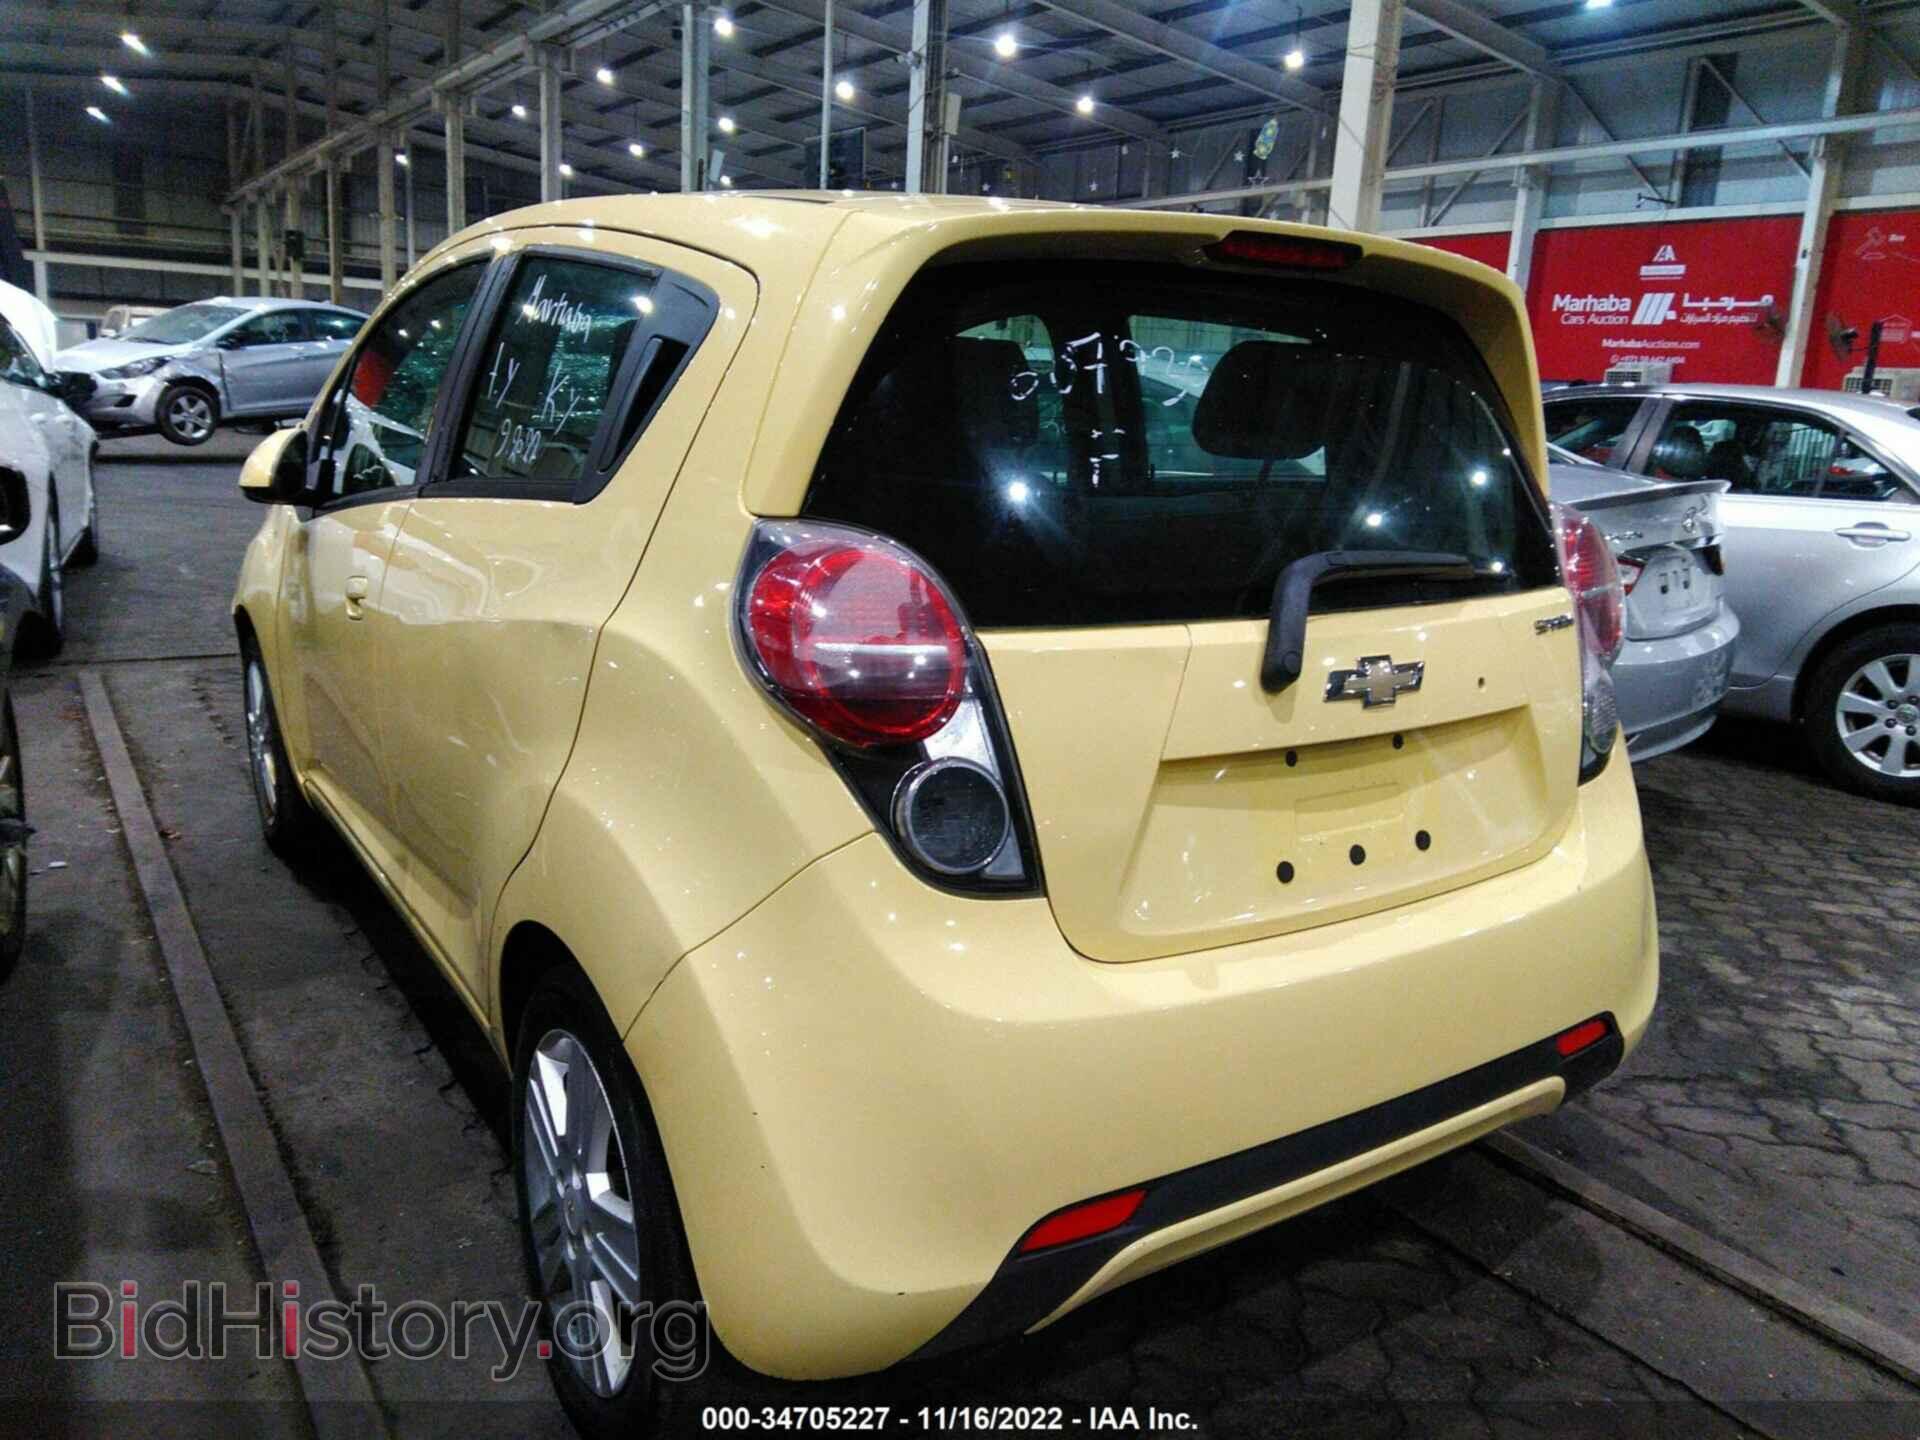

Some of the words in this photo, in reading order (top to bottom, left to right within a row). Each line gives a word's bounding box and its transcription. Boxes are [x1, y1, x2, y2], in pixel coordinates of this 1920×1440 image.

[1552, 294, 1632, 312] Marhaba
[1560, 312, 1585, 325] Cars
[1586, 312, 1630, 325] Auction
